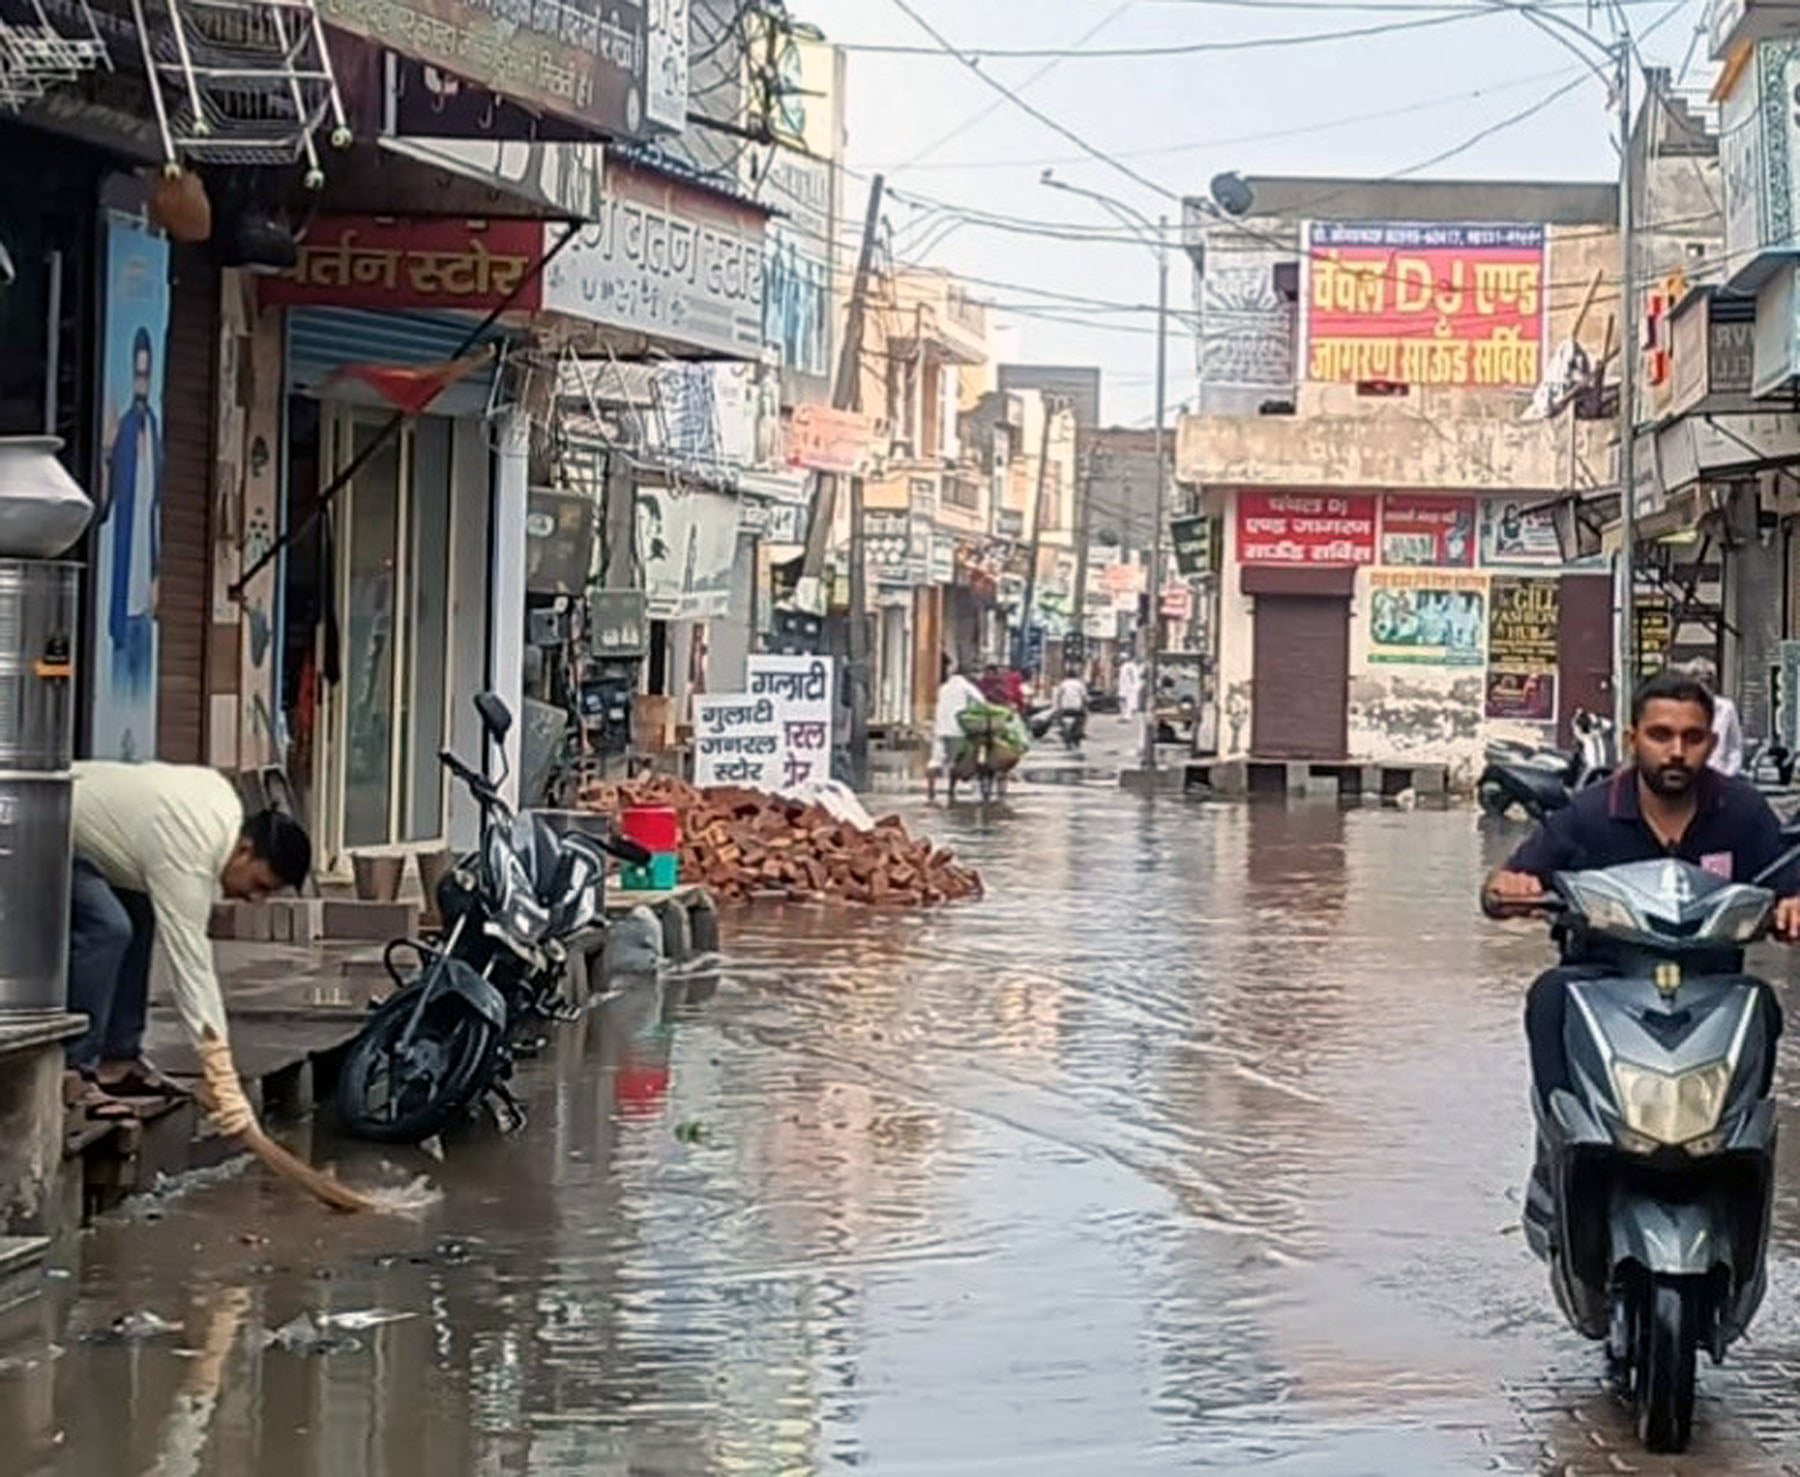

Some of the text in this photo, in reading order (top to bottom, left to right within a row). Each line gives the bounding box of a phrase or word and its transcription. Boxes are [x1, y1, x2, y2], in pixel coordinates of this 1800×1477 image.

[406, 238, 529, 296] स्टोर
[1397, 257, 1464, 315] DJ
[1309, 336, 1400, 382] जागरण
[702, 698, 773, 734] गुलाटी
[714, 757, 763, 781] स्टोर
